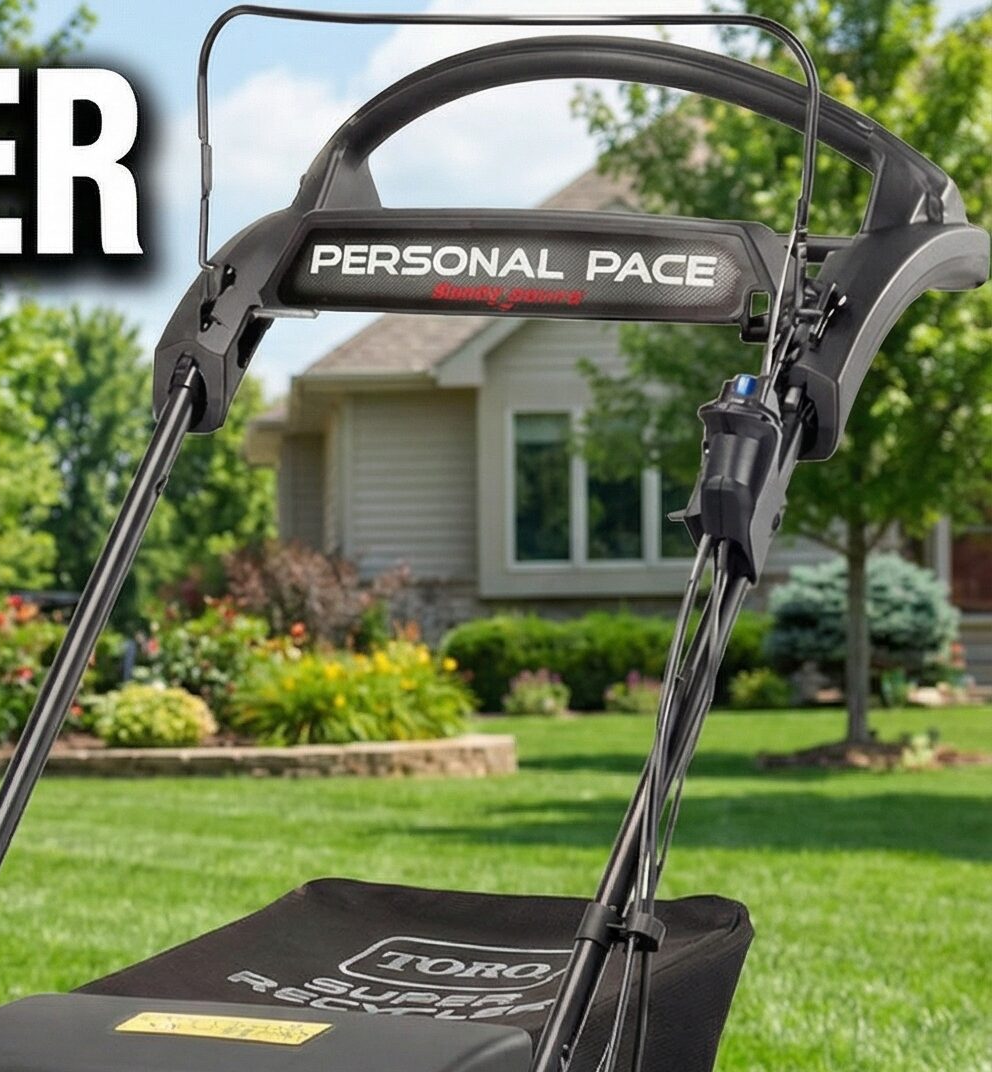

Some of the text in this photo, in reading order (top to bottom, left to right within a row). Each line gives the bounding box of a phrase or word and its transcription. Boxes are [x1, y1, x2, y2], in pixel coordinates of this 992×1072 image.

[309, 244, 718, 287] PERSONAL PACE
[376, 951, 551, 980] TORO
